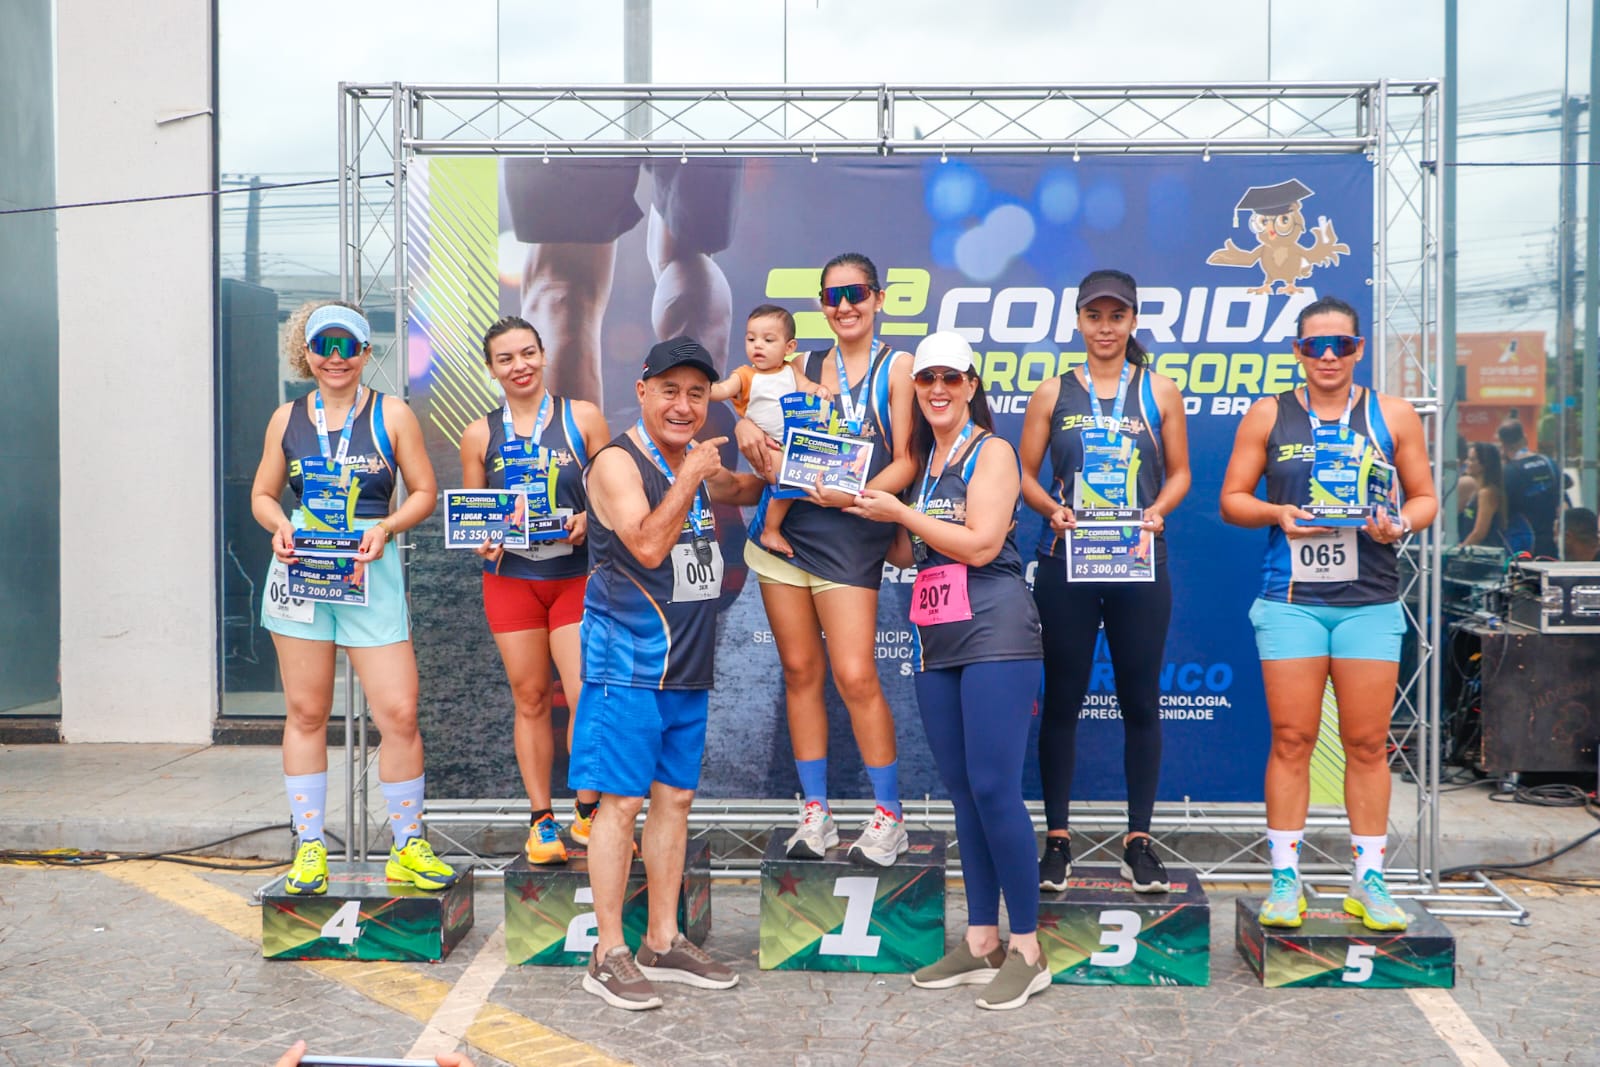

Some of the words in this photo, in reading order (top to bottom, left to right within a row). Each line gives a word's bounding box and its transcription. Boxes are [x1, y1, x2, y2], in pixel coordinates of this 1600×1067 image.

[800, 454, 822, 464] LUGAR
[788, 470, 802, 479] R$
[804, 472, 838, 483] 40,00
[453, 530, 465, 540] R$
[1300, 543, 1346, 566] 065
[300, 571, 320, 579] LUGAR
[687, 563, 715, 585] 001
[1075, 563, 1088, 575] R$
[1092, 564, 1128, 576] 300,00
[292, 583, 305, 595] R$
[308, 586, 342, 599] 200,00
[919, 584, 951, 610] 207
[320, 900, 361, 945] 4
[818, 876, 882, 957] 1
[1089, 909, 1142, 967] 3
[1341, 945, 1377, 983] 5
